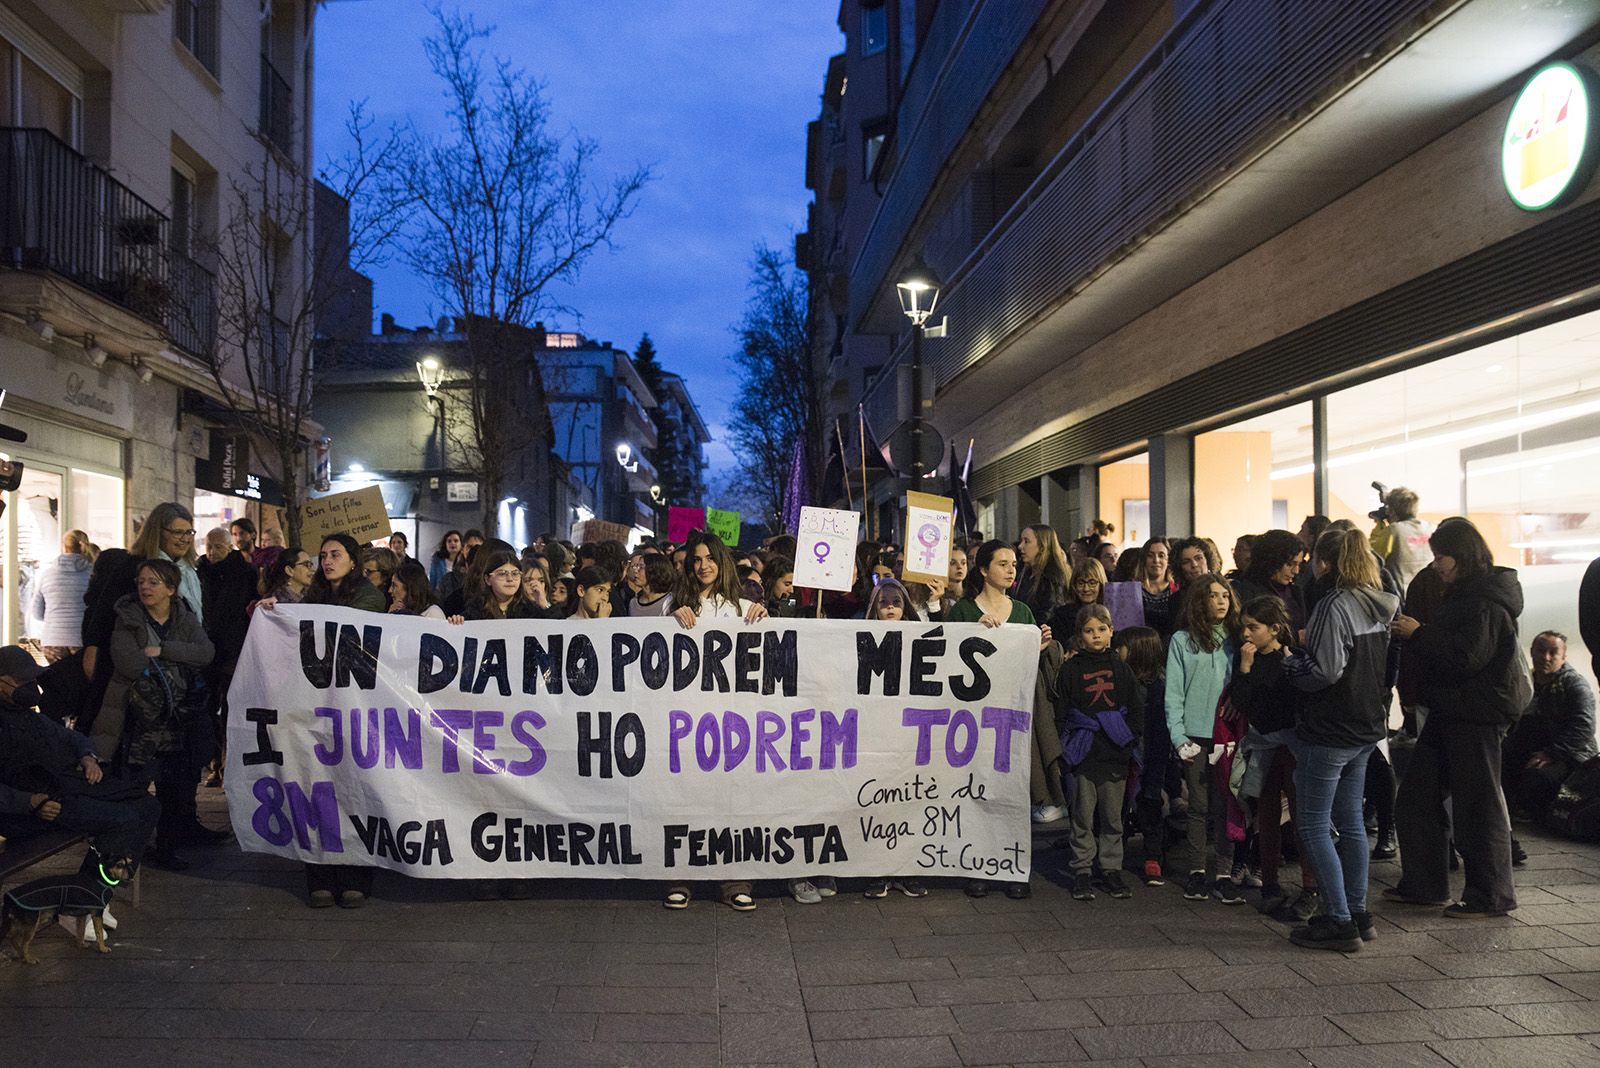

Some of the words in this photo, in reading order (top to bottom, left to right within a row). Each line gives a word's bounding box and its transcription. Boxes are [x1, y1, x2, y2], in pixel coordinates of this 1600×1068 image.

[299, 620, 382, 689] UN
[418, 633, 511, 696] DIA
[522, 634, 598, 696] NO
[612, 630, 798, 697] PODREM
[856, 625, 998, 702] MÉS
[243, 708, 283, 766] I
[314, 707, 547, 777] JUNTES
[577, 711, 646, 778] HO
[669, 708, 858, 773] PODREM
[902, 707, 1031, 773] TOT
[252, 777, 343, 852] 8M
[349, 815, 453, 866] VAGA
[471, 812, 642, 865] GENERAL
[858, 774, 939, 808] Comitè
[951, 773, 987, 801] de
[860, 816, 914, 850] Vaga
[923, 805, 961, 838] 8M
